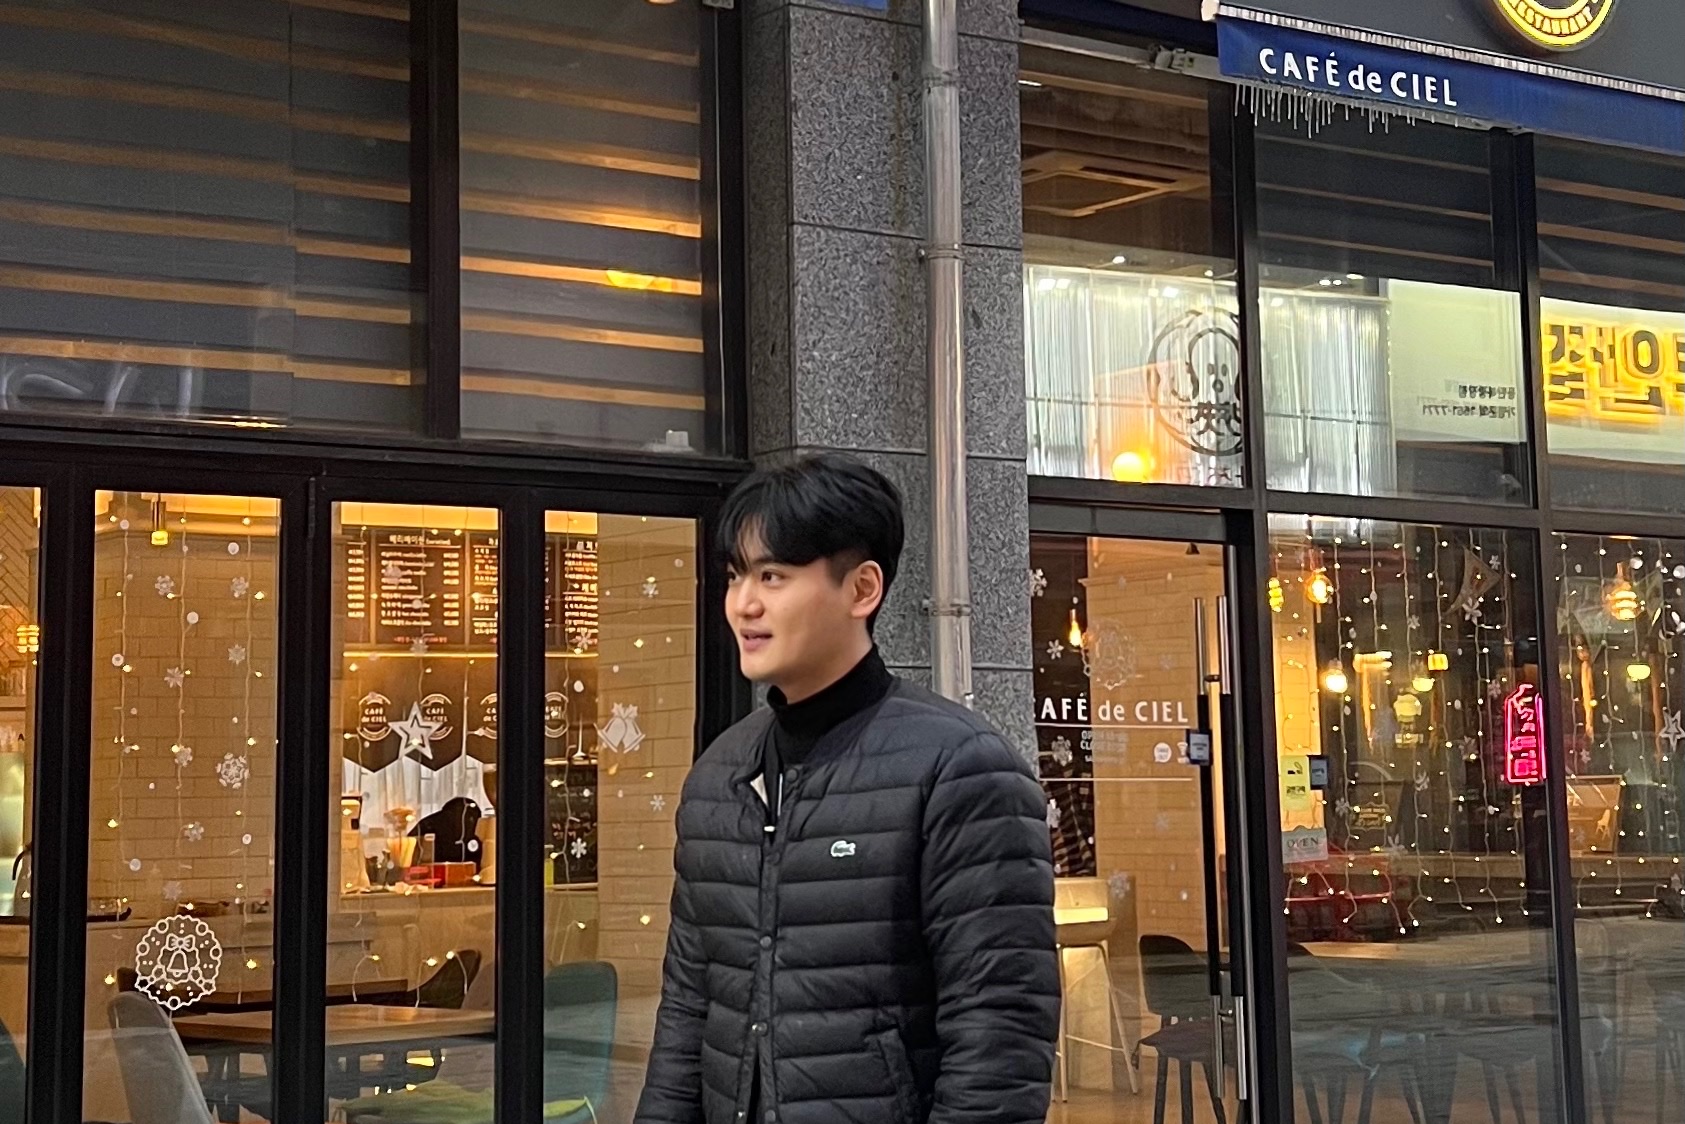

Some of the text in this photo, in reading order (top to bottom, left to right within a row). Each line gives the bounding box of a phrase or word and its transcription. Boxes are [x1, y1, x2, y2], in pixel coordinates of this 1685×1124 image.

[1259, 48, 1457, 106] CAFÉ de CIEL
[1033, 691, 1188, 723] AFÉ de CIEL
